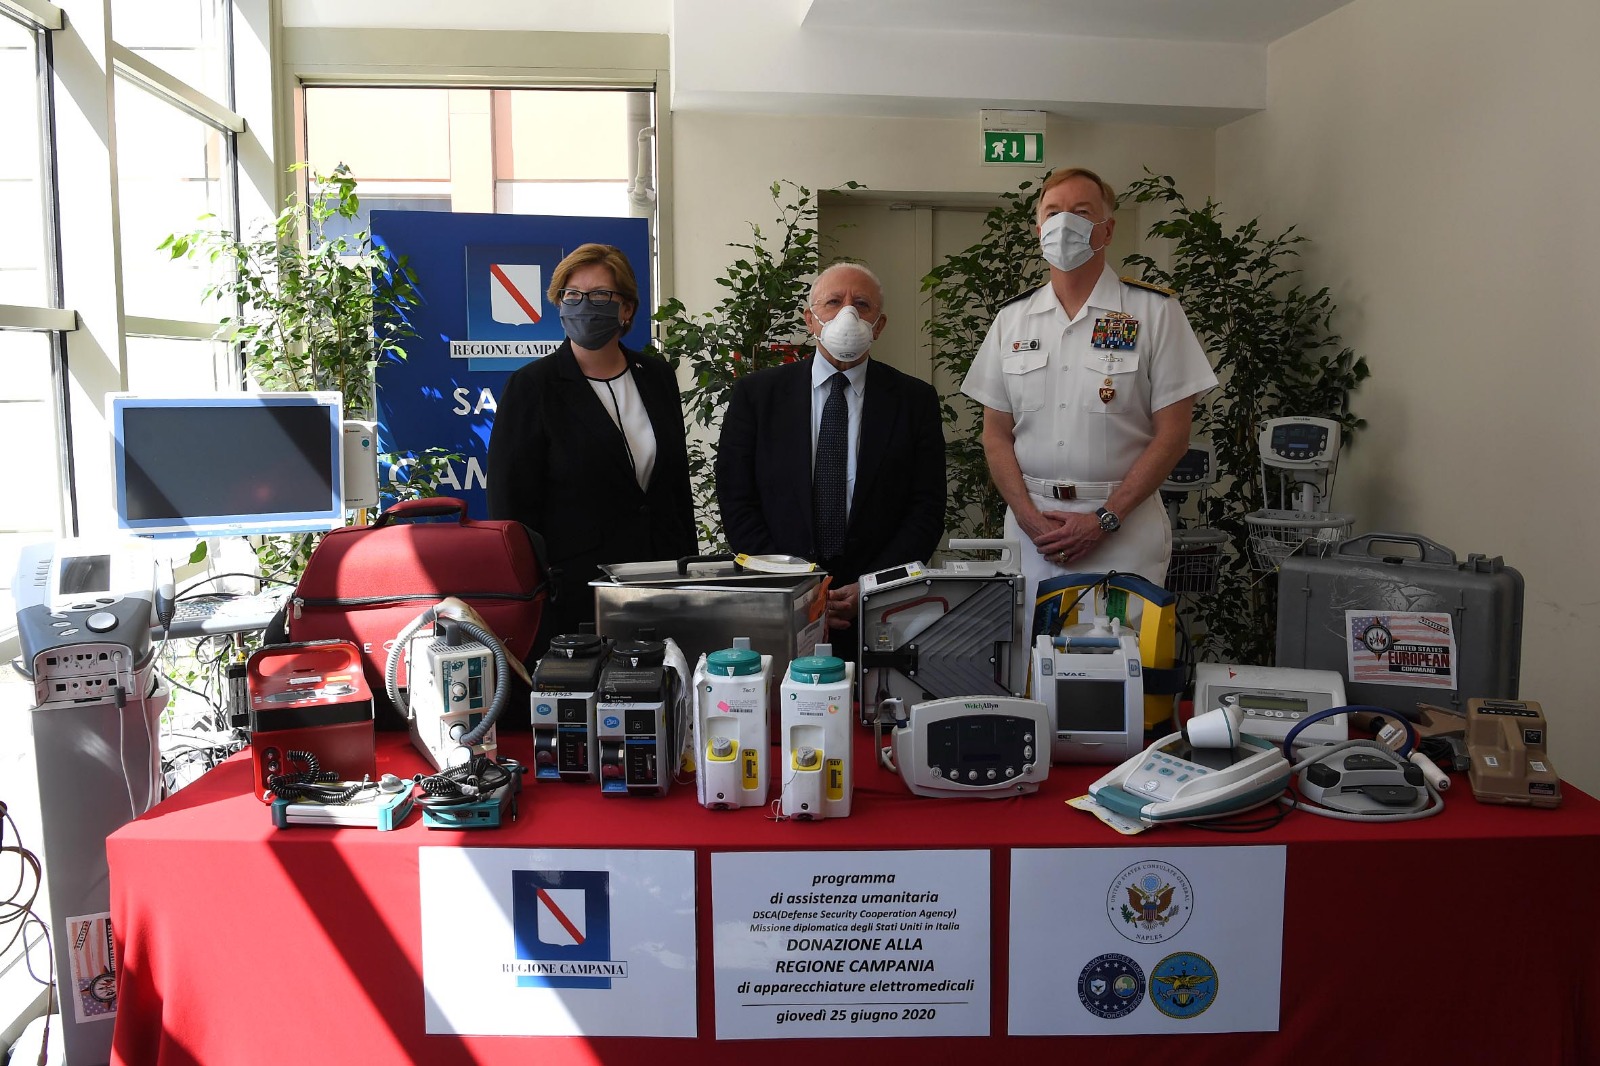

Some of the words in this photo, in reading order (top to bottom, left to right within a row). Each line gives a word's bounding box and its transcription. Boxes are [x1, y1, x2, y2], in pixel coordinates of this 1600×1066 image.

[453, 344, 512, 355] REGIONE
[452, 387, 498, 416] SA
[1388, 651, 1450, 668] EUROPEAN
[1401, 666, 1436, 674] COMMAND
[812, 874, 895, 886] programma
[1111, 881, 1123, 903] UNITED
[1121, 865, 1141, 881] STATES
[1142, 864, 1177, 877] CONSULATE
[1176, 875, 1190, 902] GENERAL
[770, 893, 783, 904] di
[787, 892, 857, 904] assistenza
[862, 891, 938, 903] umanitaria
[753, 910, 818, 920] DSCA(Defense
[820, 910, 857, 920] Security
[860, 910, 917, 919] Cooperation
[919, 909, 957, 919] Agency)
[750, 923, 791, 932] Missione
[793, 923, 848, 933] diplomatica
[850, 923, 873, 932] degli
[876, 923, 897, 931] Stati
[900, 923, 922, 931] Uniti
[925, 923, 933, 931] in
[936, 922, 959, 931] Italia
[1136, 933, 1163, 941] NAPLES
[787, 938, 881, 951] DONAZIONE
[885, 938, 922, 950] ALLA
[776, 960, 844, 973] REGIONE
[849, 960, 934, 972] CAMPANIA
[1085, 957, 1102, 971] NAVAL
[1103, 953, 1131, 964] FORCES
[560, 964, 624, 975] CAMPANIA
[738, 982, 750, 994] di
[754, 981, 865, 995] apparecchiature
[869, 979, 974, 992] elettromedicali
[1084, 1002, 1101, 1017] NAVAL
[1102, 1009, 1129, 1019] FORCES
[1129, 992, 1144, 1012] AFRICA
[777, 1009, 827, 1024] giovedì
[830, 1009, 846, 1021] 25
[850, 1009, 898, 1023] giugno
[901, 1008, 935, 1020] 2020
